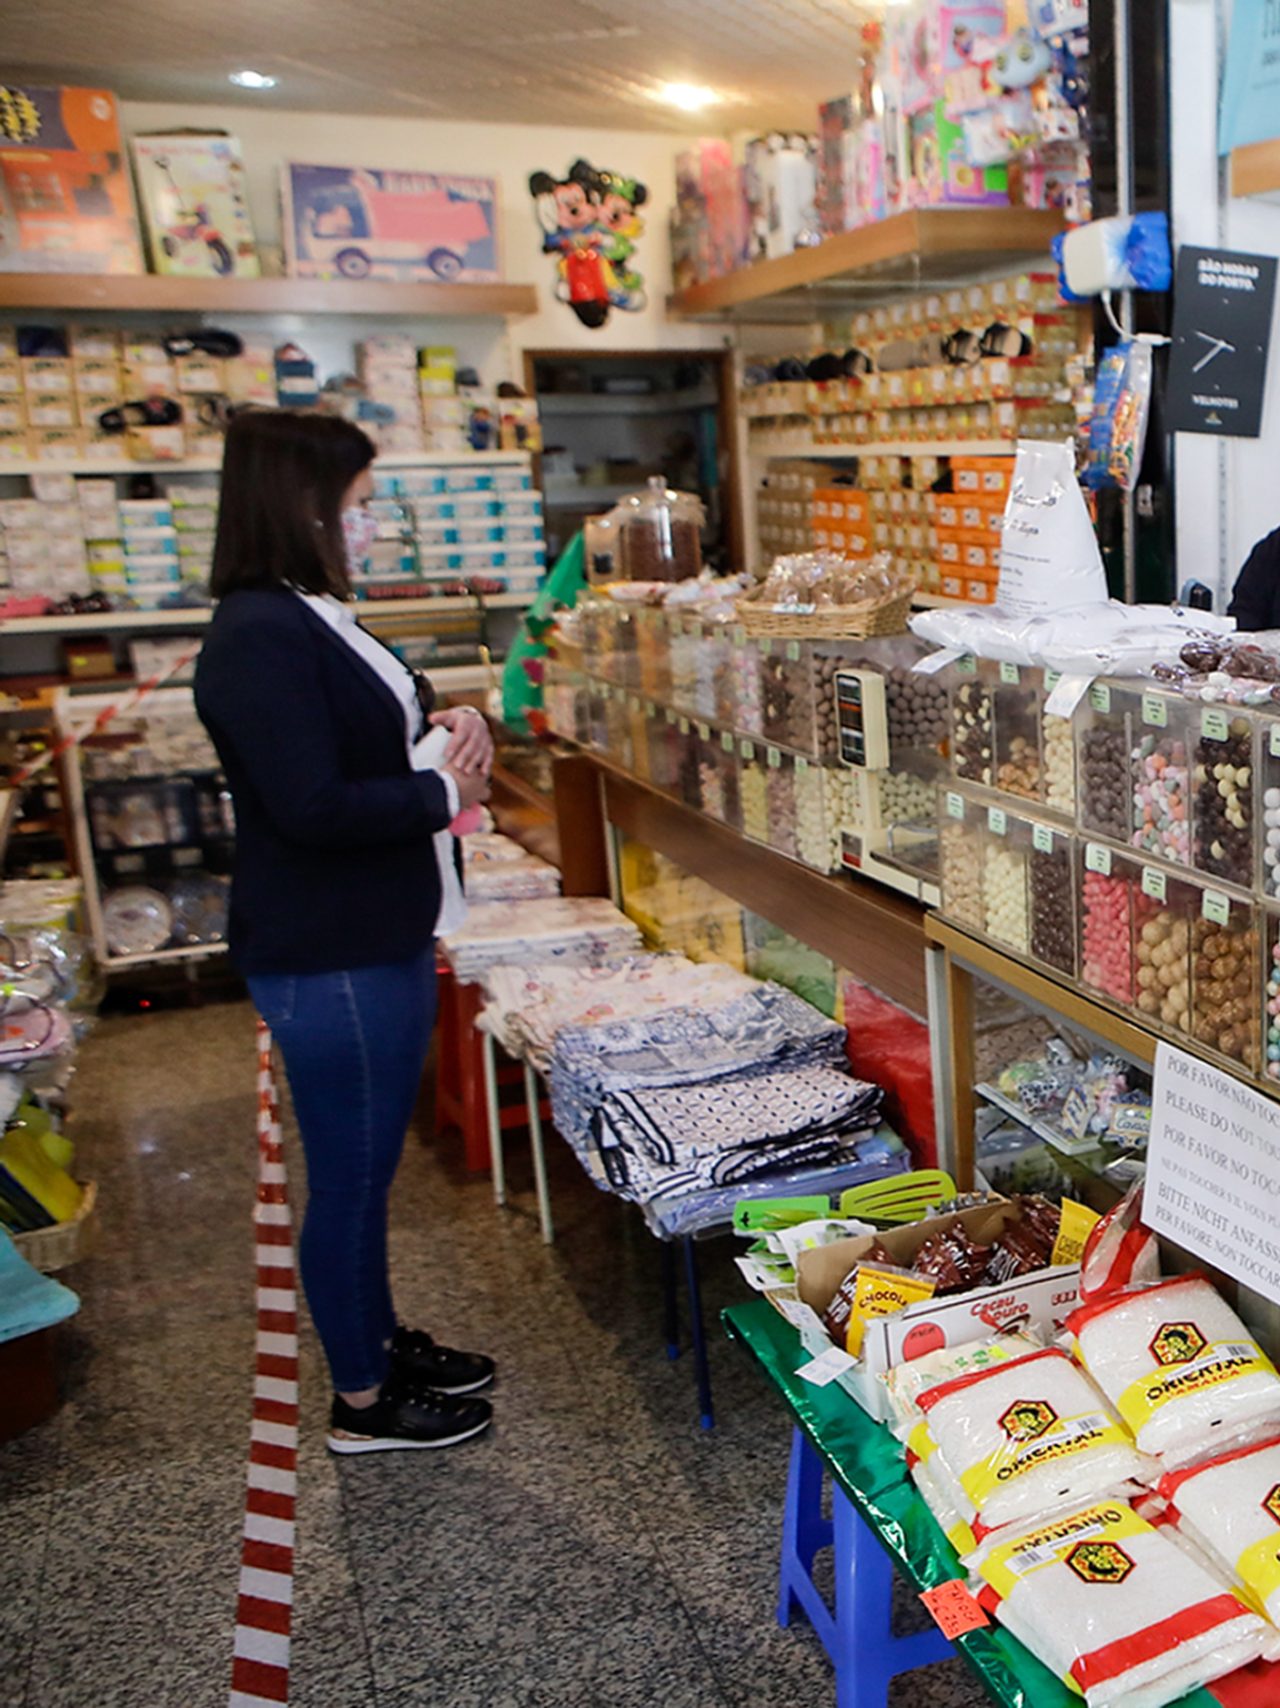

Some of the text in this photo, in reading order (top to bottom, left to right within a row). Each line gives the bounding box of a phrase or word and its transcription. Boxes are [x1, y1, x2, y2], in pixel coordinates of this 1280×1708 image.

[1167, 1055, 1190, 1078] POR
[1191, 1067, 1231, 1098] FAVOR
[1165, 1090, 1208, 1124] PLEASE
[1210, 1111, 1229, 1133] DO
[1231, 1122, 1254, 1147] NOT
[1163, 1124, 1186, 1148] POR
[1188, 1137, 1228, 1171] FAVOR
[1230, 1158, 1249, 1181] NO
[1155, 1204, 1172, 1225] PER
[1173, 1216, 1212, 1248] FAVORE
[1215, 1239, 1237, 1262] NON
[1158, 1181, 1190, 1212] BITTE
[1192, 1201, 1228, 1232] NICHT
